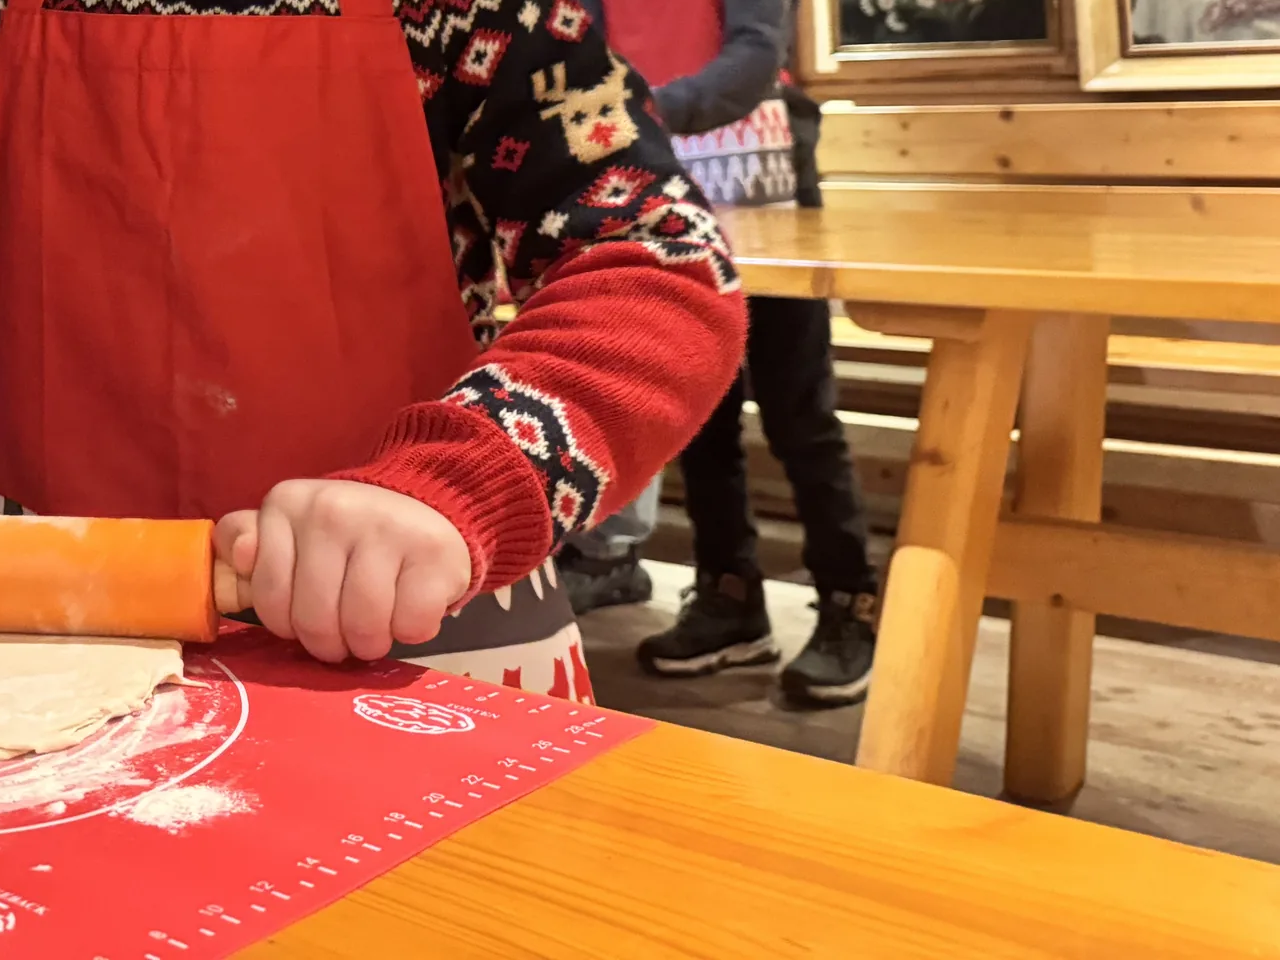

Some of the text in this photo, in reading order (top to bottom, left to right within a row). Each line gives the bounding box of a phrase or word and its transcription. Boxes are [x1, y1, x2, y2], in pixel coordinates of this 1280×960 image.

[198, 904, 224, 916] 10
[249, 880, 275, 893] 12
[297, 856, 320, 869] 14
[341, 833, 364, 845] 16
[383, 811, 406, 823] 18
[422, 792, 445, 804] 20
[460, 774, 485, 786] 22
[497, 756, 519, 769] 24
[531, 739, 553, 751] 26
